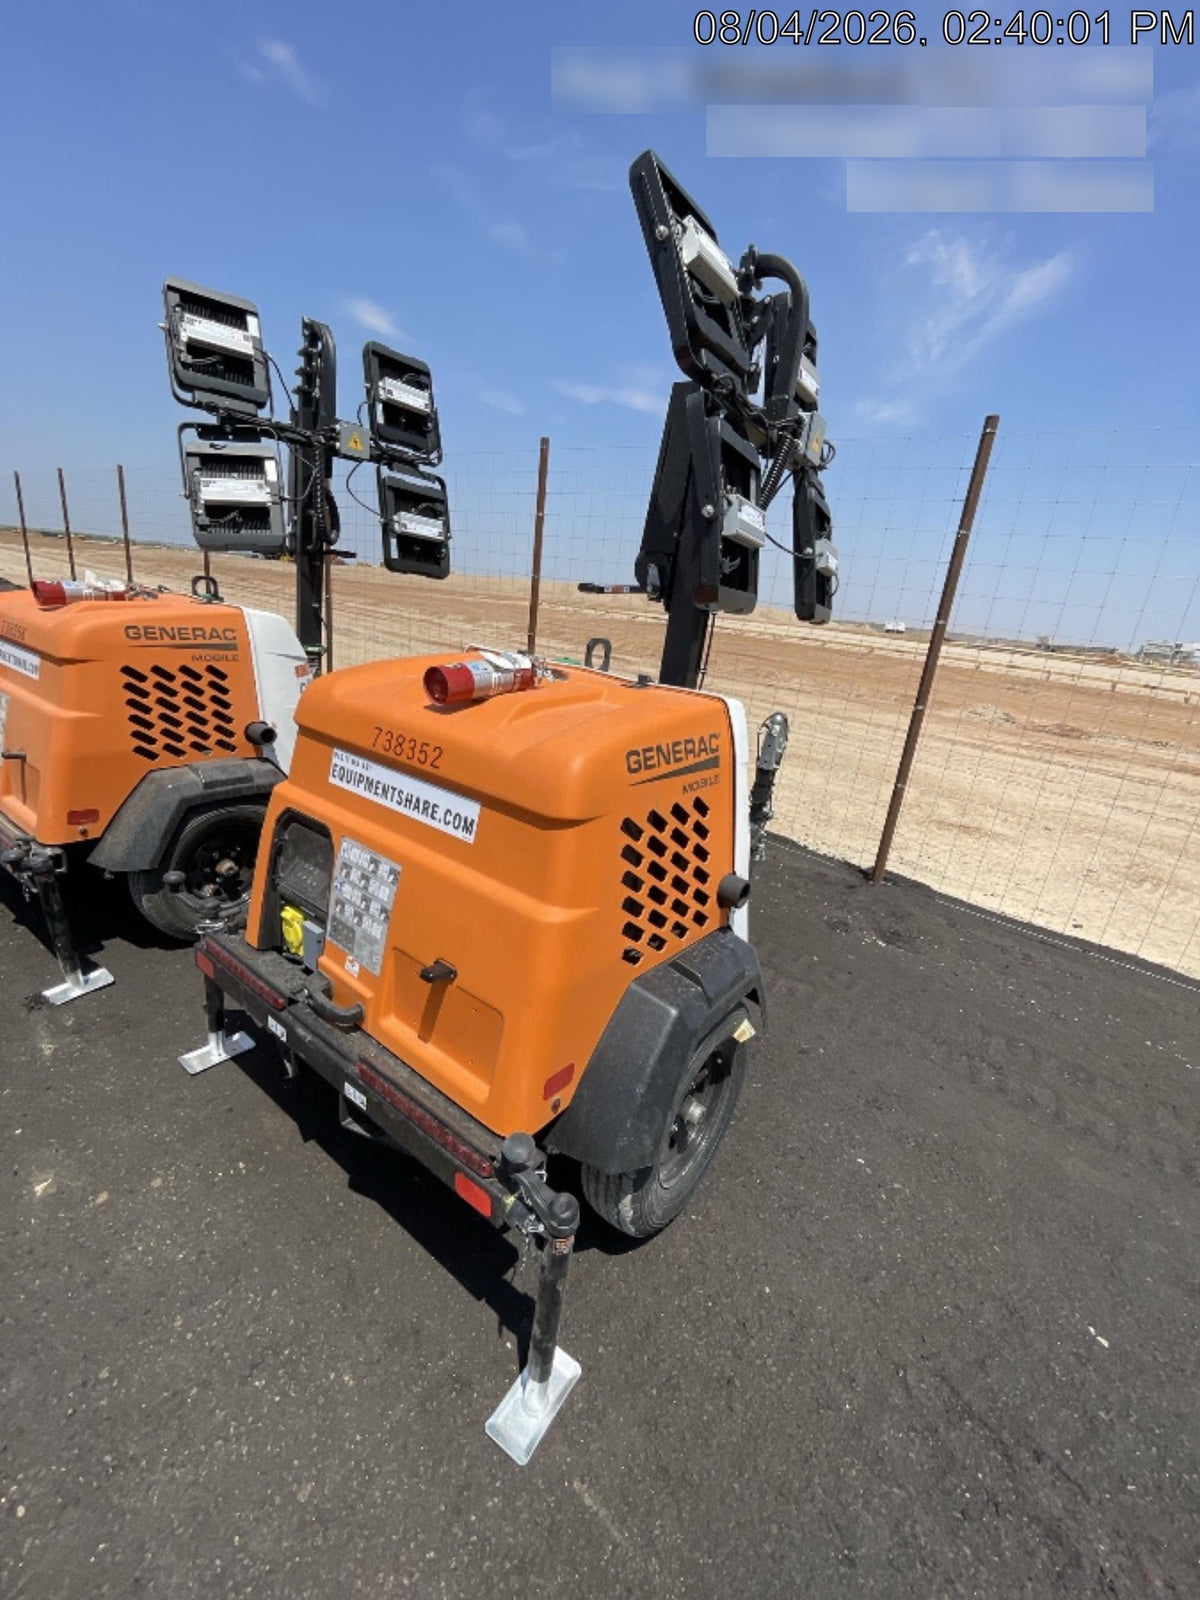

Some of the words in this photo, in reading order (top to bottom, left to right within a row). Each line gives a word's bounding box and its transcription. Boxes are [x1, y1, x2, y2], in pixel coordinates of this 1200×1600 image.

[124, 625, 237, 641] GENERAC
[191, 653, 240, 663] MOBILE
[372, 726, 444, 769] 738352
[625, 732, 720, 774] GENERAC
[331, 763, 476, 836] EQUIPMENTSHARE.COM
[682, 774, 720, 796] MOBILE
